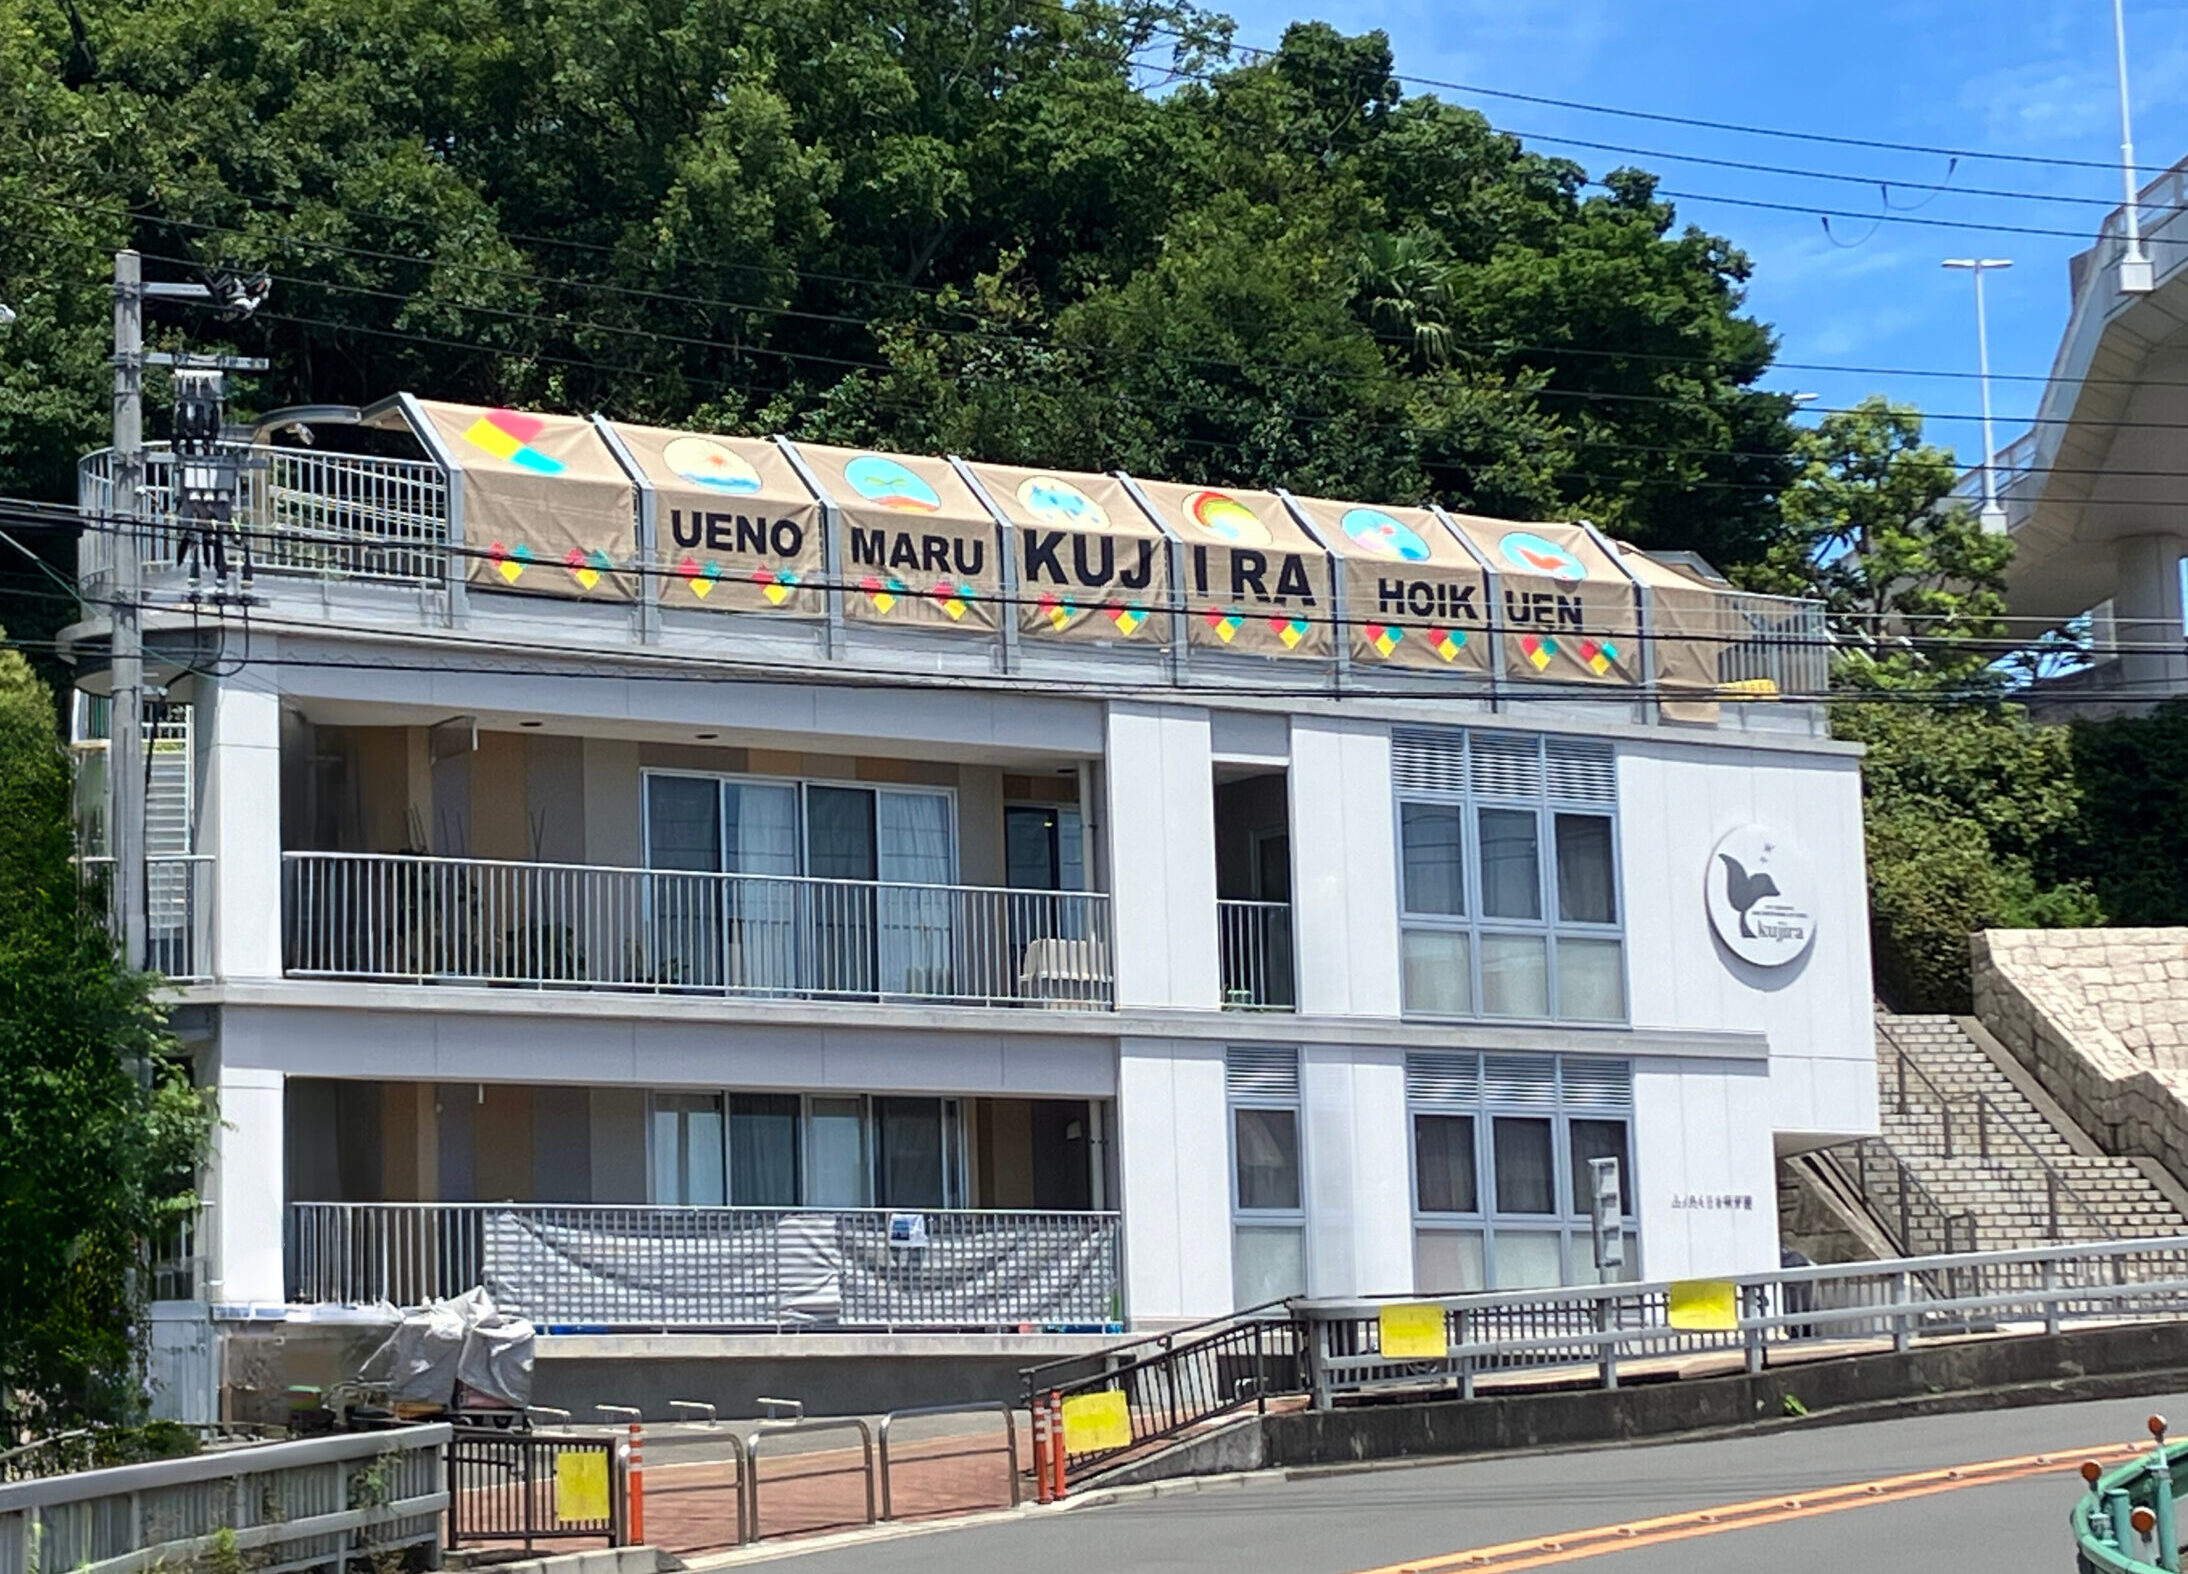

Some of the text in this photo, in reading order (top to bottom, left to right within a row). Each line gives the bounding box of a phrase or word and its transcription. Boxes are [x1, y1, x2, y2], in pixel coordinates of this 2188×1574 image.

[671, 509, 803, 557] UENO
[850, 526, 984, 575] MARU
[1757, 920, 1804, 942] kujira
